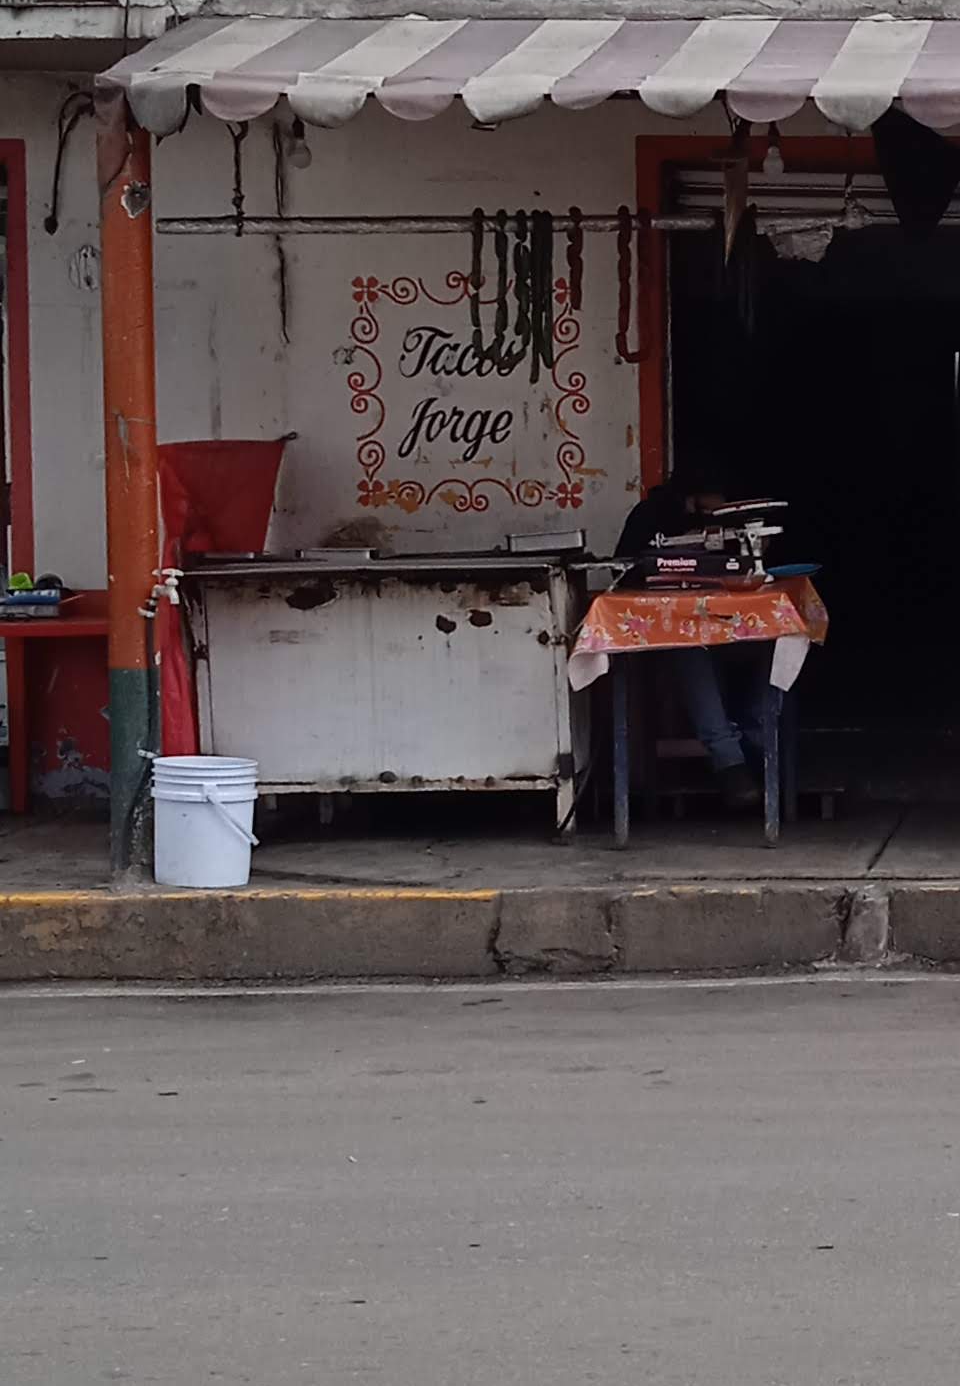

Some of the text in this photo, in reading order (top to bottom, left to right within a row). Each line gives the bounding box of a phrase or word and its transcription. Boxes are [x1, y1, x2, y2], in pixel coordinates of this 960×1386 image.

[399, 325, 520, 378] Tacos
[398, 397, 514, 462] Jorge
[656, 557, 697, 567] Premium
